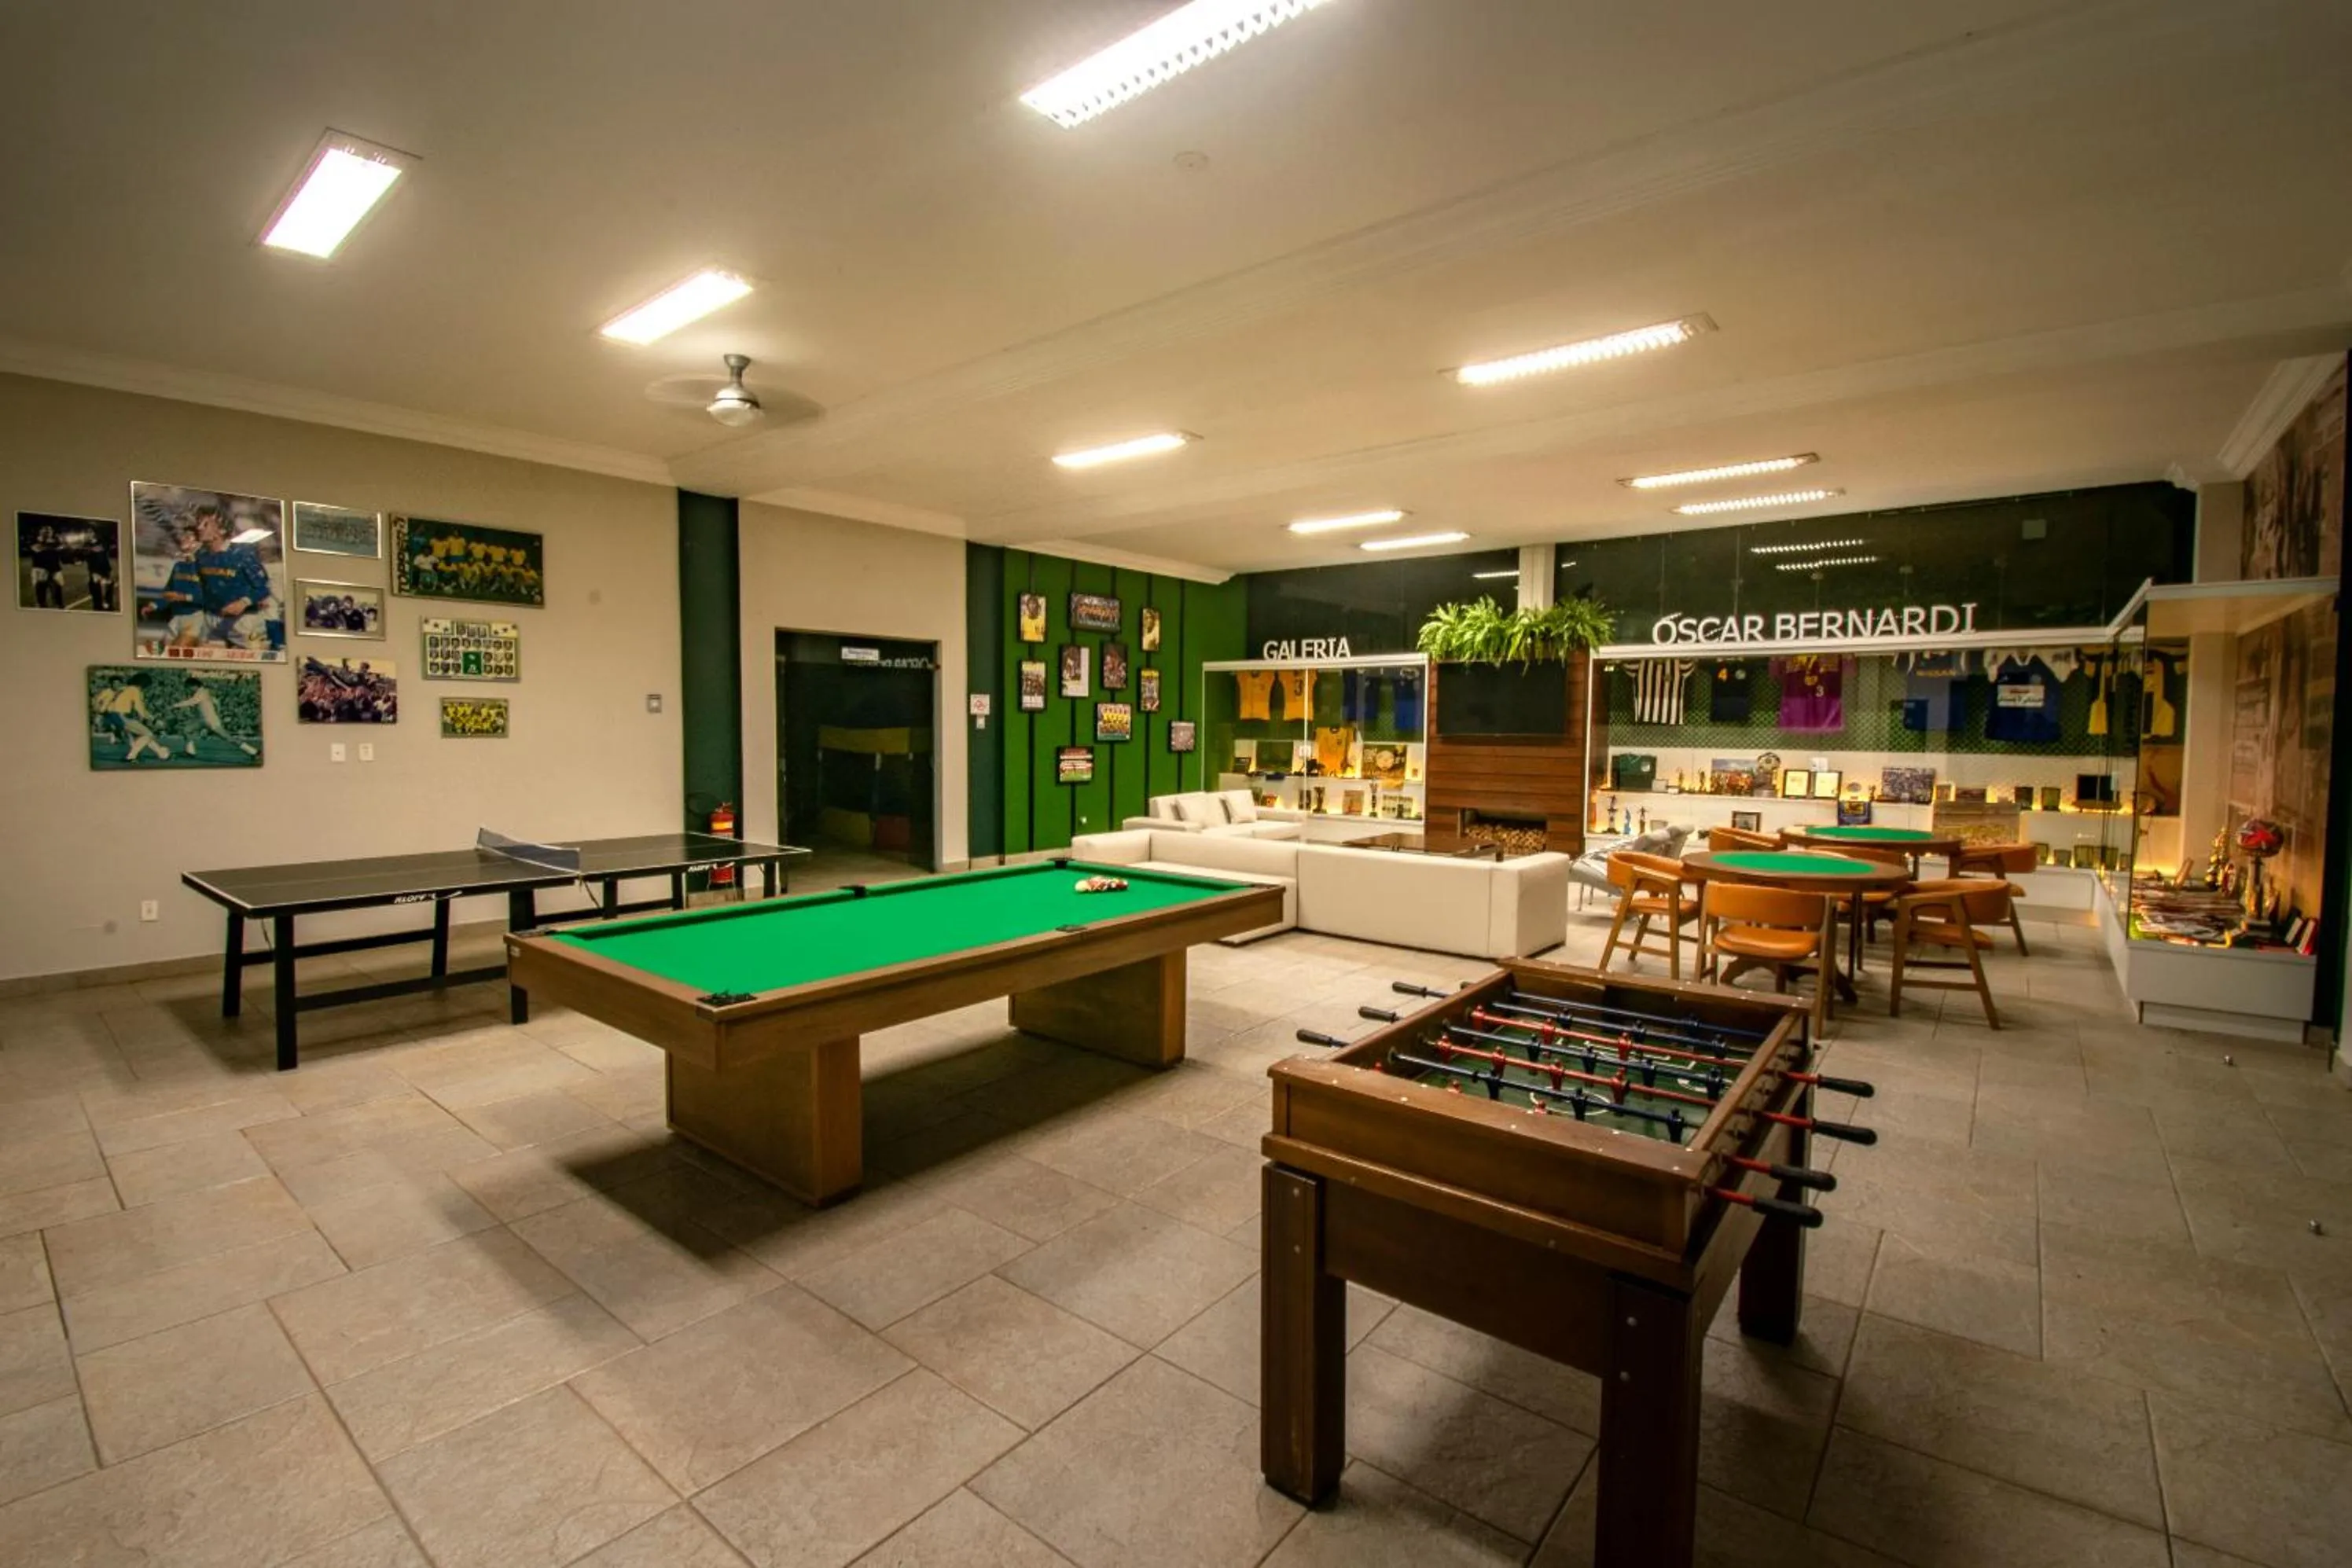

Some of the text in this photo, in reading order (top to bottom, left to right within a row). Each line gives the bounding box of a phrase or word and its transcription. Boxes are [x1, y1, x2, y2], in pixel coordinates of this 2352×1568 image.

[1774, 603, 1977, 641] BERNARDI
[1262, 636, 1351, 660] GALERIA
[1815, 685, 1825, 697] 3
